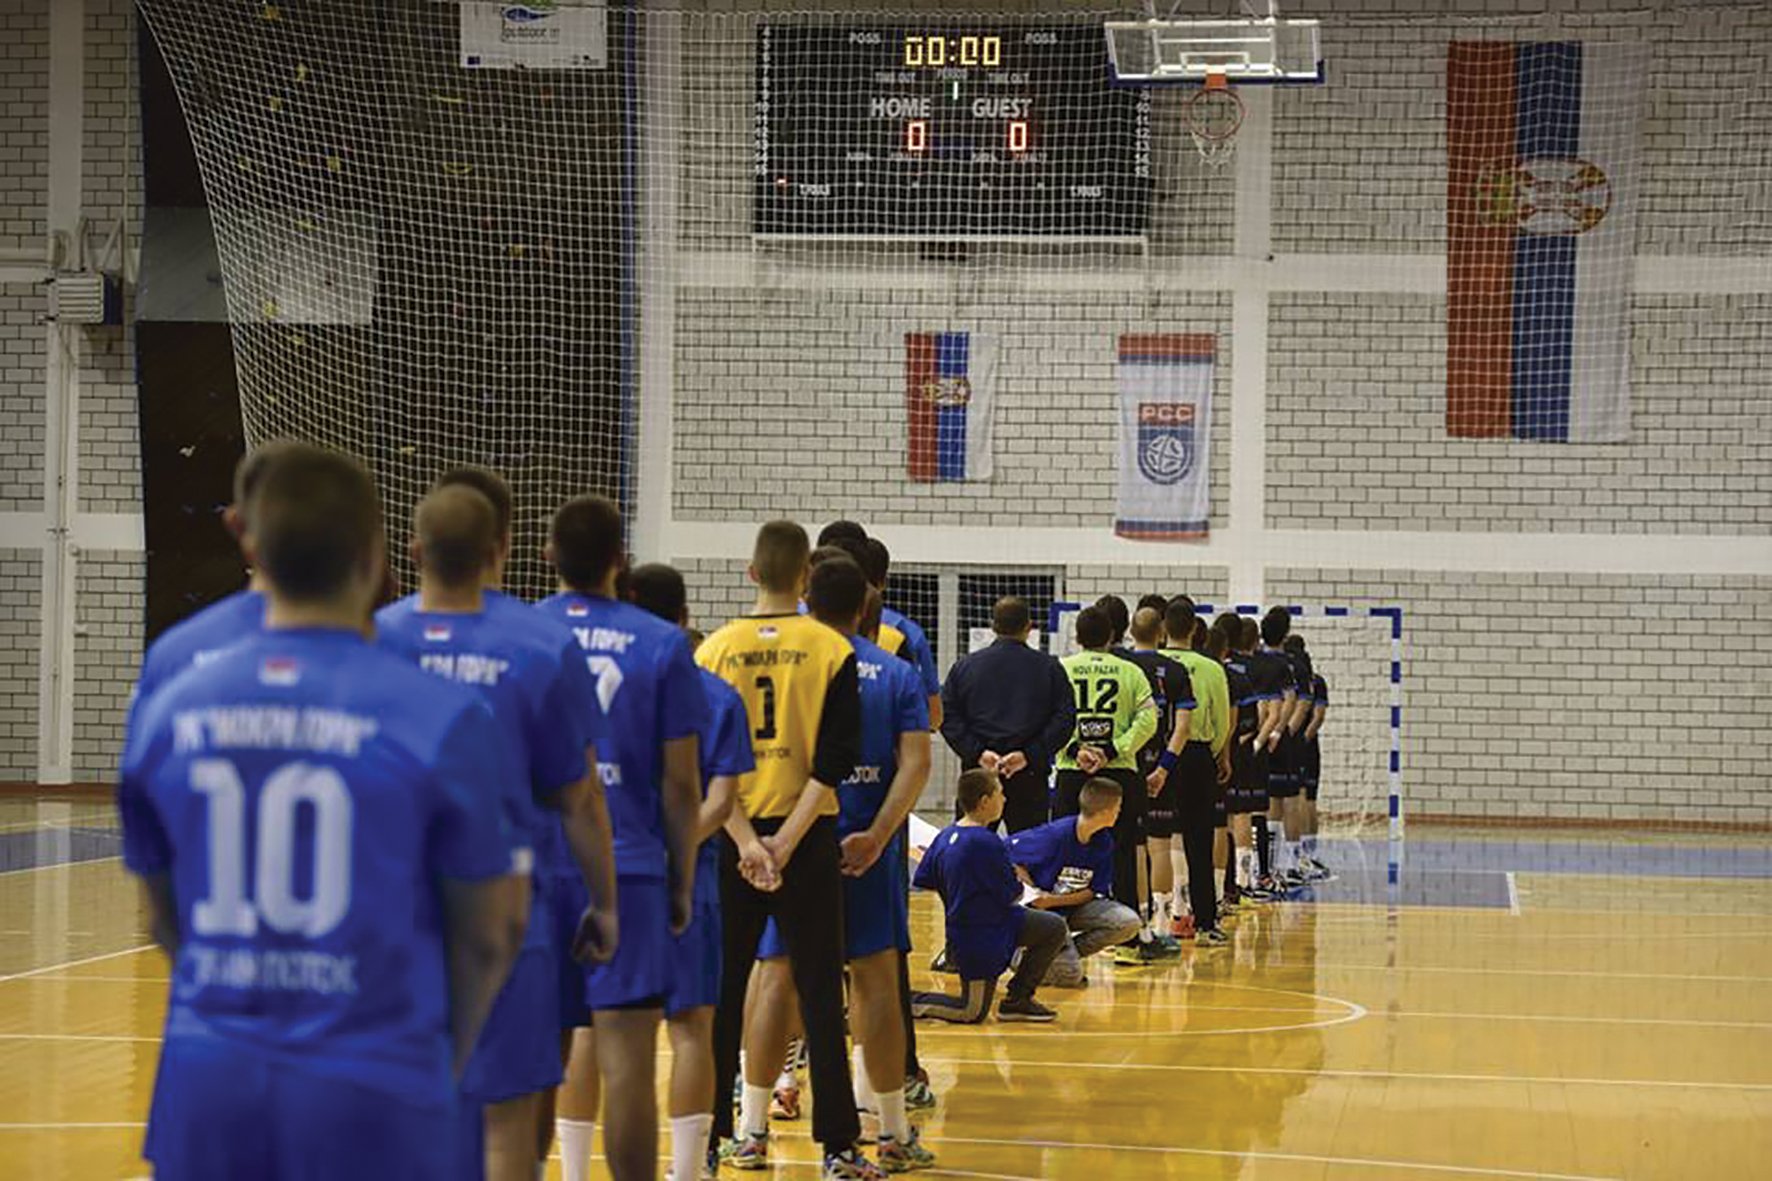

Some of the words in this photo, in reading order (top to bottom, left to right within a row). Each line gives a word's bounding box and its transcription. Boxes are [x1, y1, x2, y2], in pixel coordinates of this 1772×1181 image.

[905, 36, 1000, 65] 00:00
[871, 98, 931, 117] HOME
[972, 98, 1032, 117] GUEST
[908, 122, 925, 150] 0
[1010, 122, 1027, 150] 0
[1073, 665, 1092, 675] NOVI
[1094, 665, 1119, 675] PAZAR
[755, 676, 776, 739] 1
[1073, 678, 1120, 714] 12
[188, 758, 354, 938] 10
